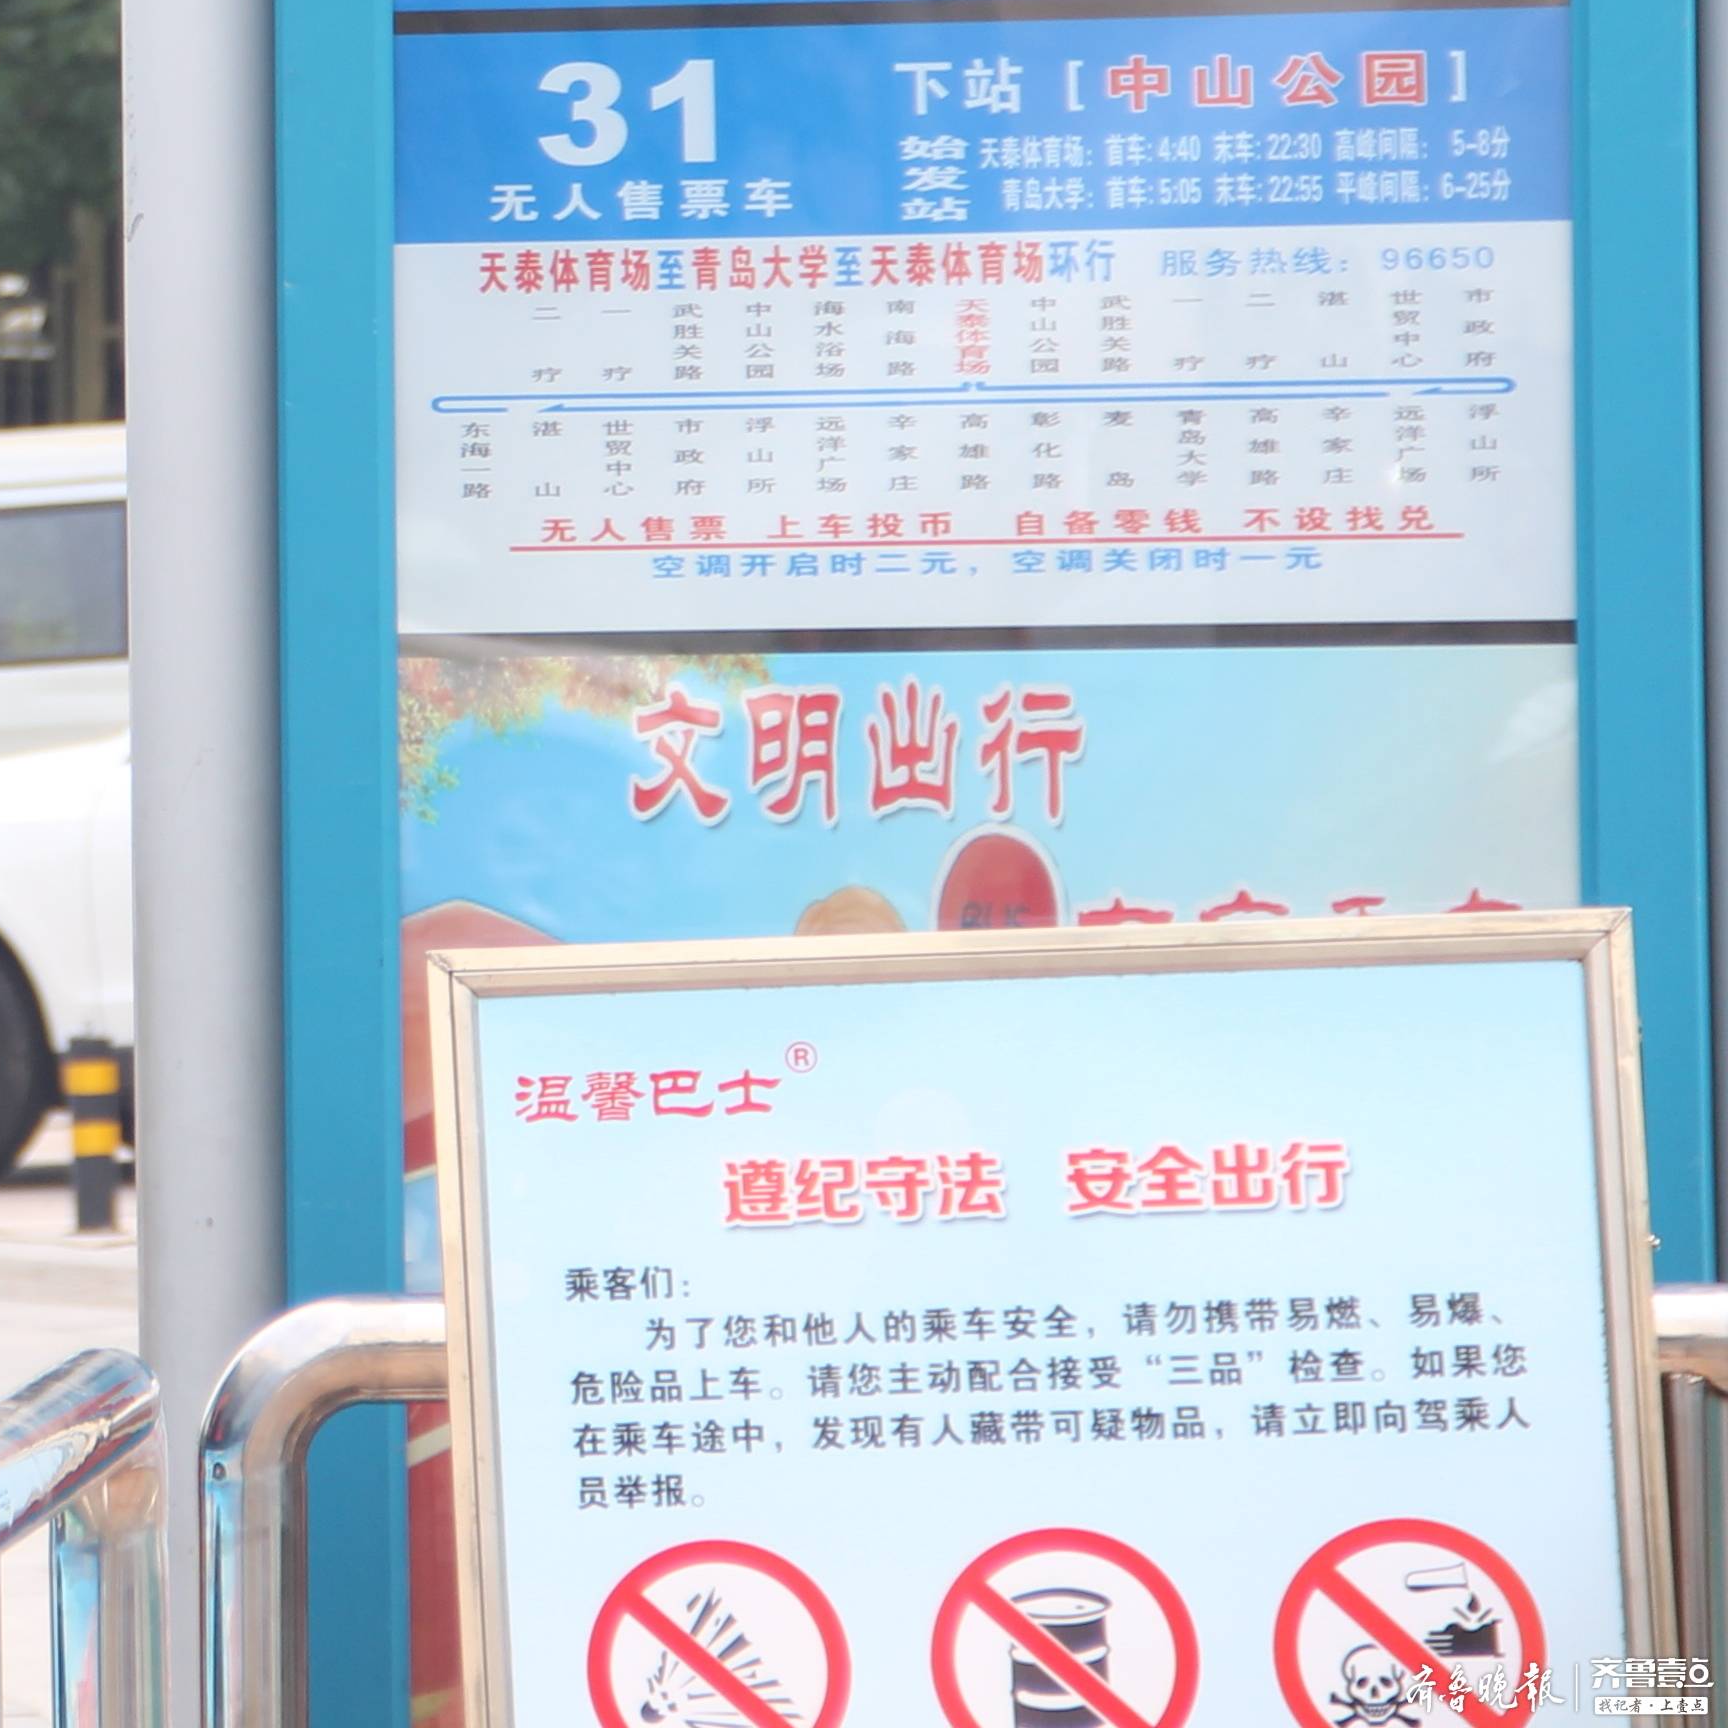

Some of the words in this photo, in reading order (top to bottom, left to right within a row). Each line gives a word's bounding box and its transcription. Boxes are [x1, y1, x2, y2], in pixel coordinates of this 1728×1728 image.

[538, 57, 718, 167] 31
[894, 55, 1024, 116] 下站
[489, 178, 794, 225] 无人售票车
[898, 134, 972, 222] 始发站
[479, 238, 1115, 294] 天泰体育场至青岛大学至天泰体育场环行
[1380, 246, 1496, 271] 96650
[671, 302, 704, 381] 武胜关路
[744, 301, 775, 379] 中山公园
[814, 300, 846, 378] 海水浴场
[886, 299, 917, 377] 南海路
[954, 298, 992, 375] 天泰体育场
[1028, 296, 1060, 374] 中山公园
[1100, 295, 1132, 373] 武胜关路
[1390, 289, 1424, 368] 世贸中心
[1463, 288, 1496, 367] 市政府
[460, 422, 492, 499] 东海一路
[602, 420, 634, 497] 世贸中心
[674, 418, 705, 496] 市政府
[745, 417, 776, 494] 浮山所
[816, 416, 847, 493] 远洋广场
[887, 415, 919, 492] 辛家庄
[959, 413, 992, 491] 高雄路
[1030, 412, 1064, 489] 彰化路
[1177, 409, 1209, 486] 青岛大学
[1248, 408, 1280, 486] 高雄路
[1322, 406, 1353, 484] 辛家庄
[1393, 406, 1427, 483] 远洋广场
[1469, 404, 1501, 482] 浮山所
[540, 515, 728, 543] 无人售票
[767, 512, 953, 540] 上车投币
[1015, 508, 1204, 536] 自备零钱
[1244, 506, 1437, 533] 不设找兑
[628, 679, 1087, 826] 文明出行
[720, 1154, 1009, 1229] 遵纪守法
[1064, 1142, 1351, 1214] 安全出行
